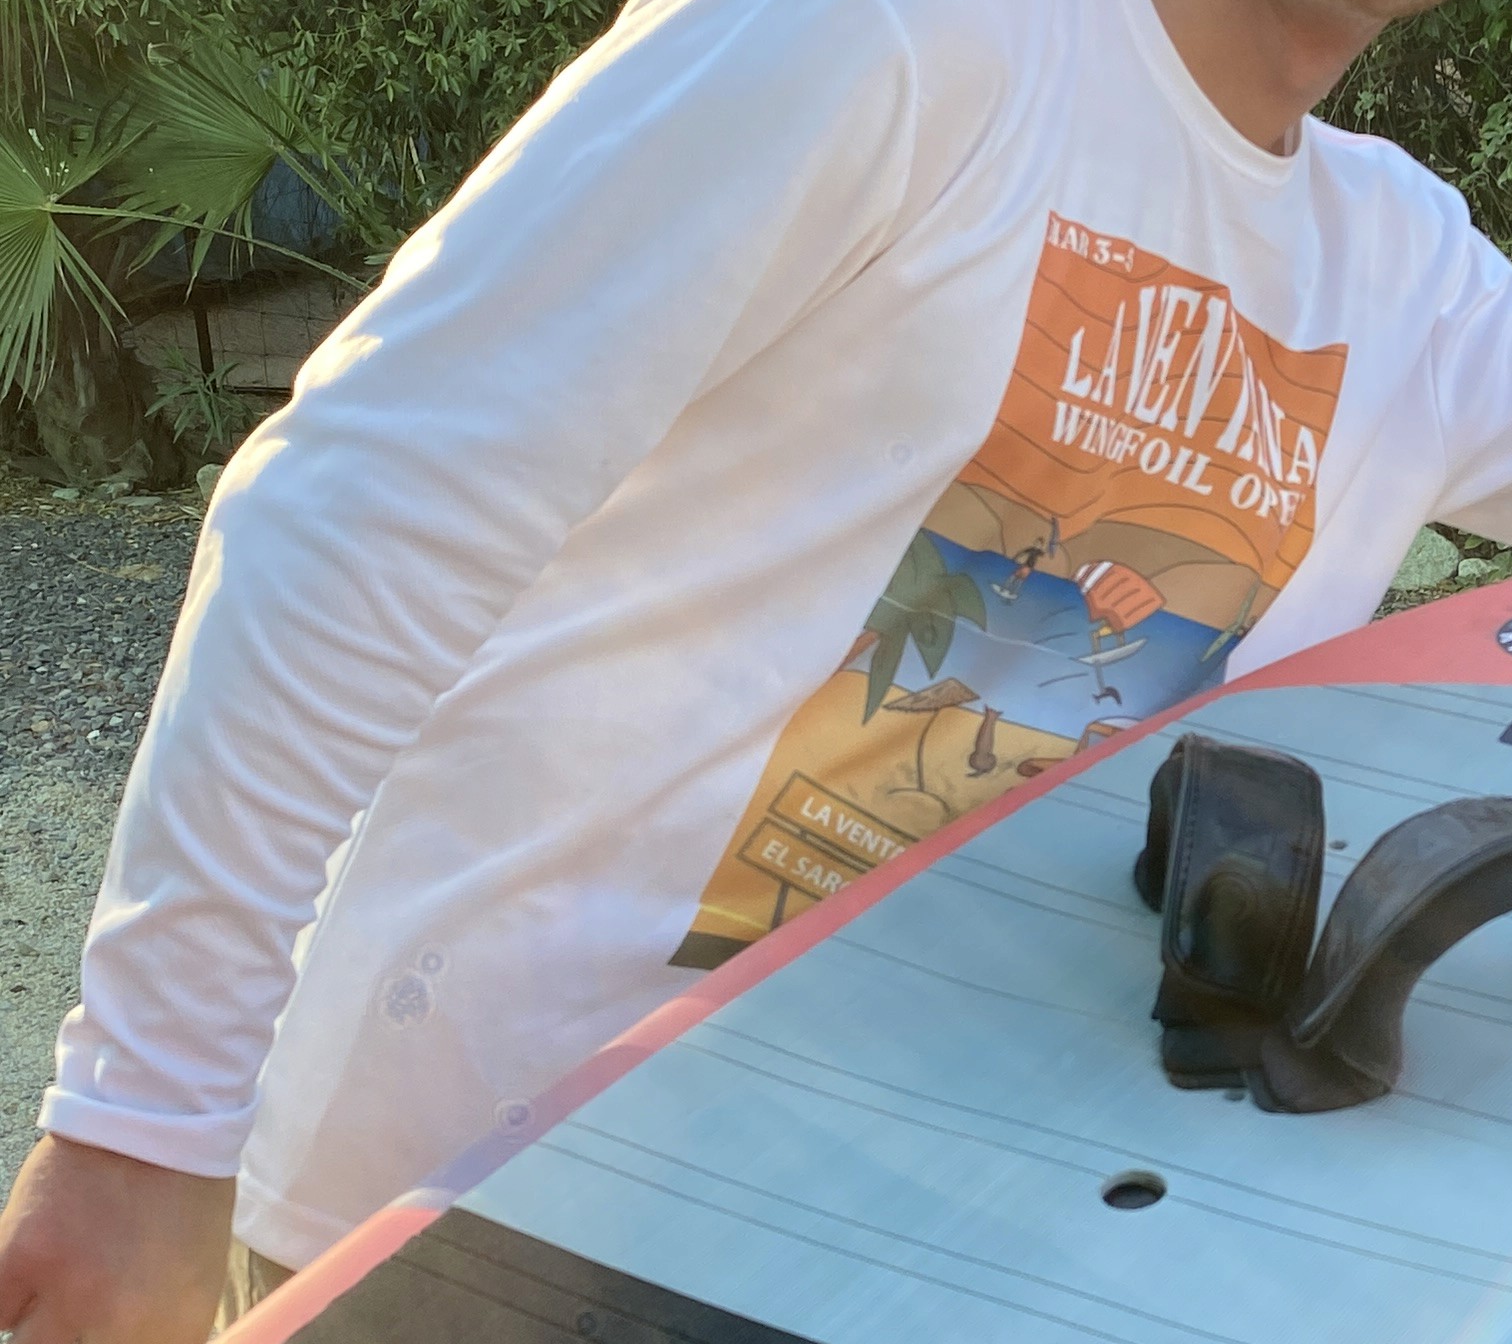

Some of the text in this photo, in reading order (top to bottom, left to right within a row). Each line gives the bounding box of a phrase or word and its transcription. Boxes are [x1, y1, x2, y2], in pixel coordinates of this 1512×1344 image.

[800, 795, 832, 828] LA
[761, 838, 851, 895] EL SAR
